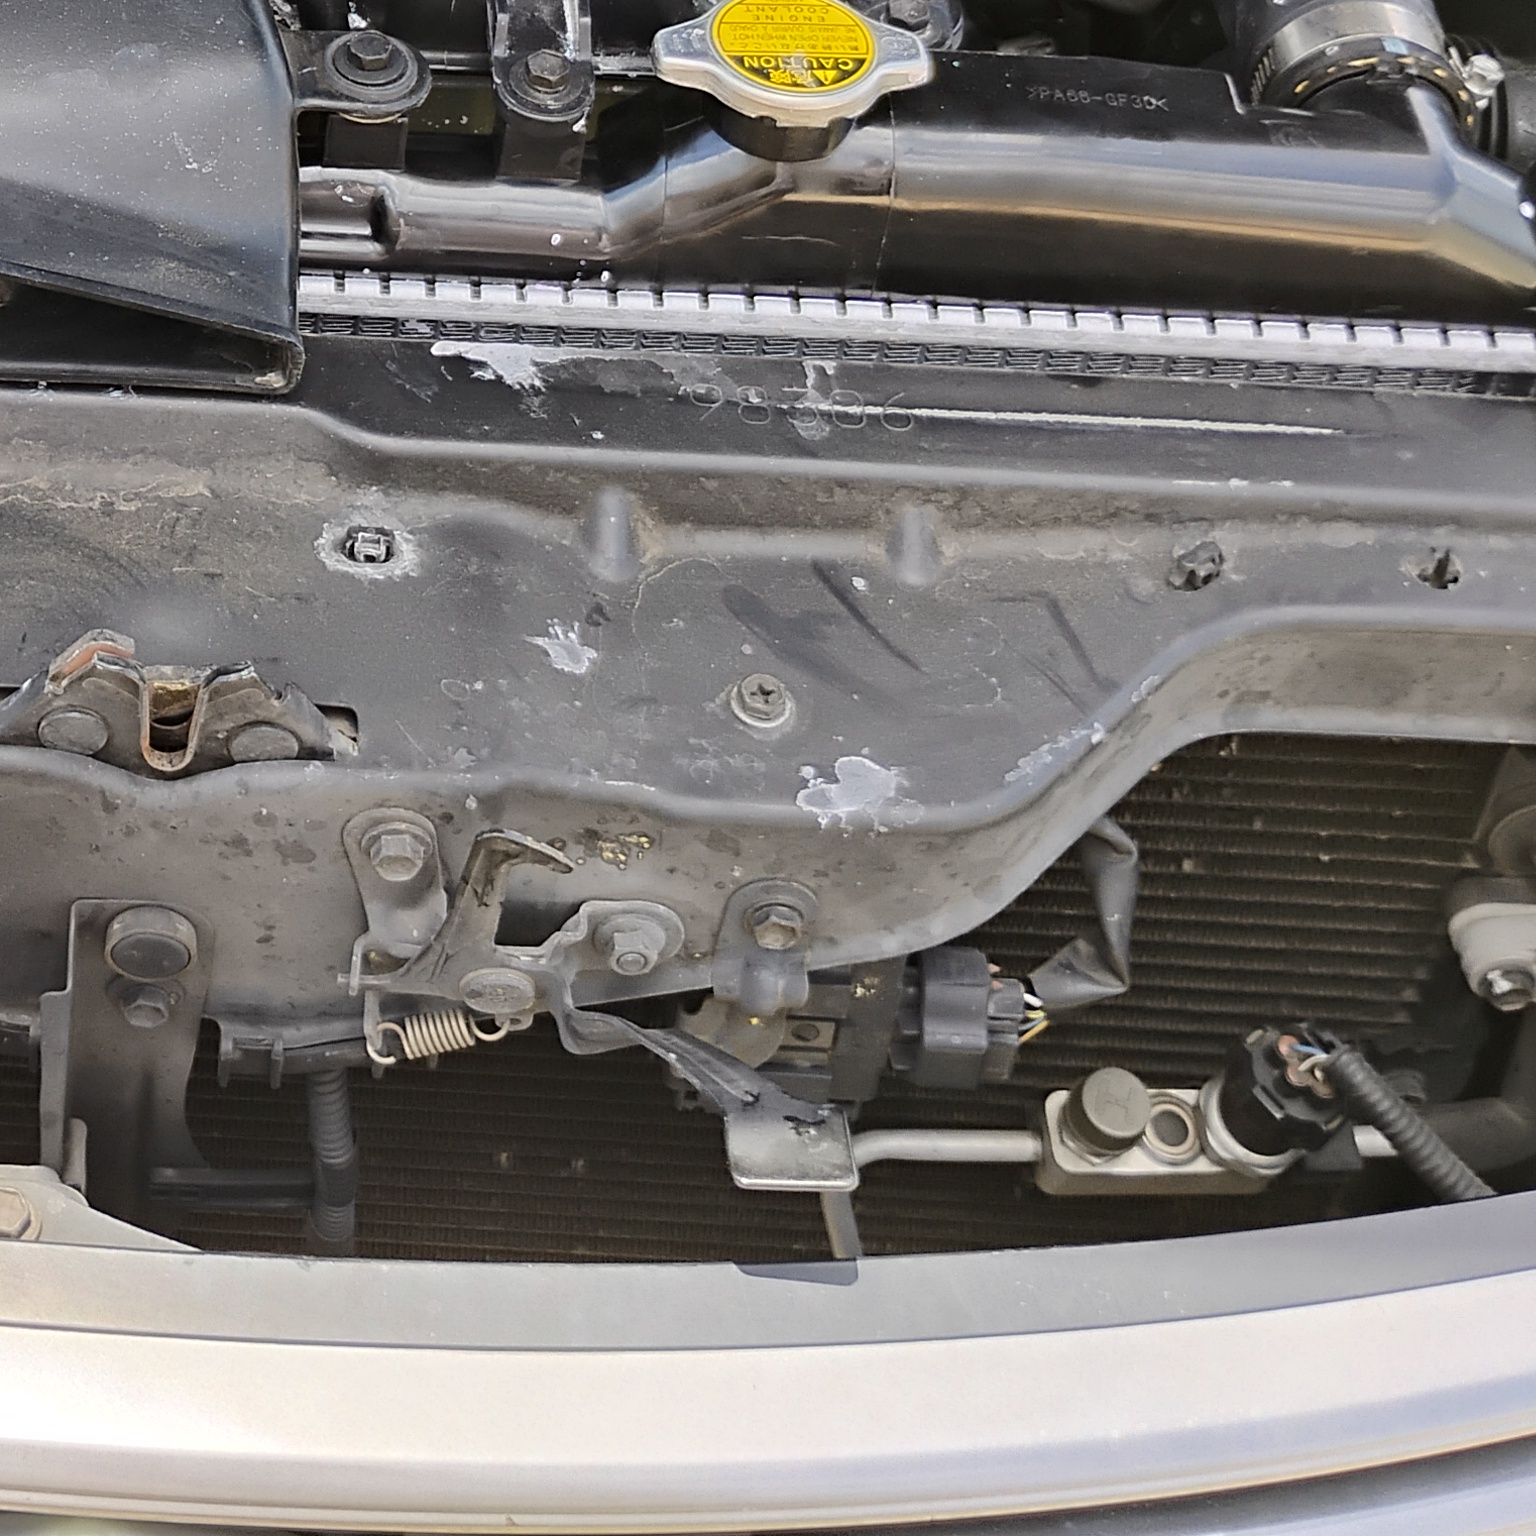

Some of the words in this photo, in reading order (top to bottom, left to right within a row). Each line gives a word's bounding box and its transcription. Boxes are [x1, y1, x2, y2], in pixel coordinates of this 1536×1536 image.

[744, 5, 829, 14] COOLANT
[752, 14, 825, 23] ENGINE
[743, 56, 853, 70] CAUTION
